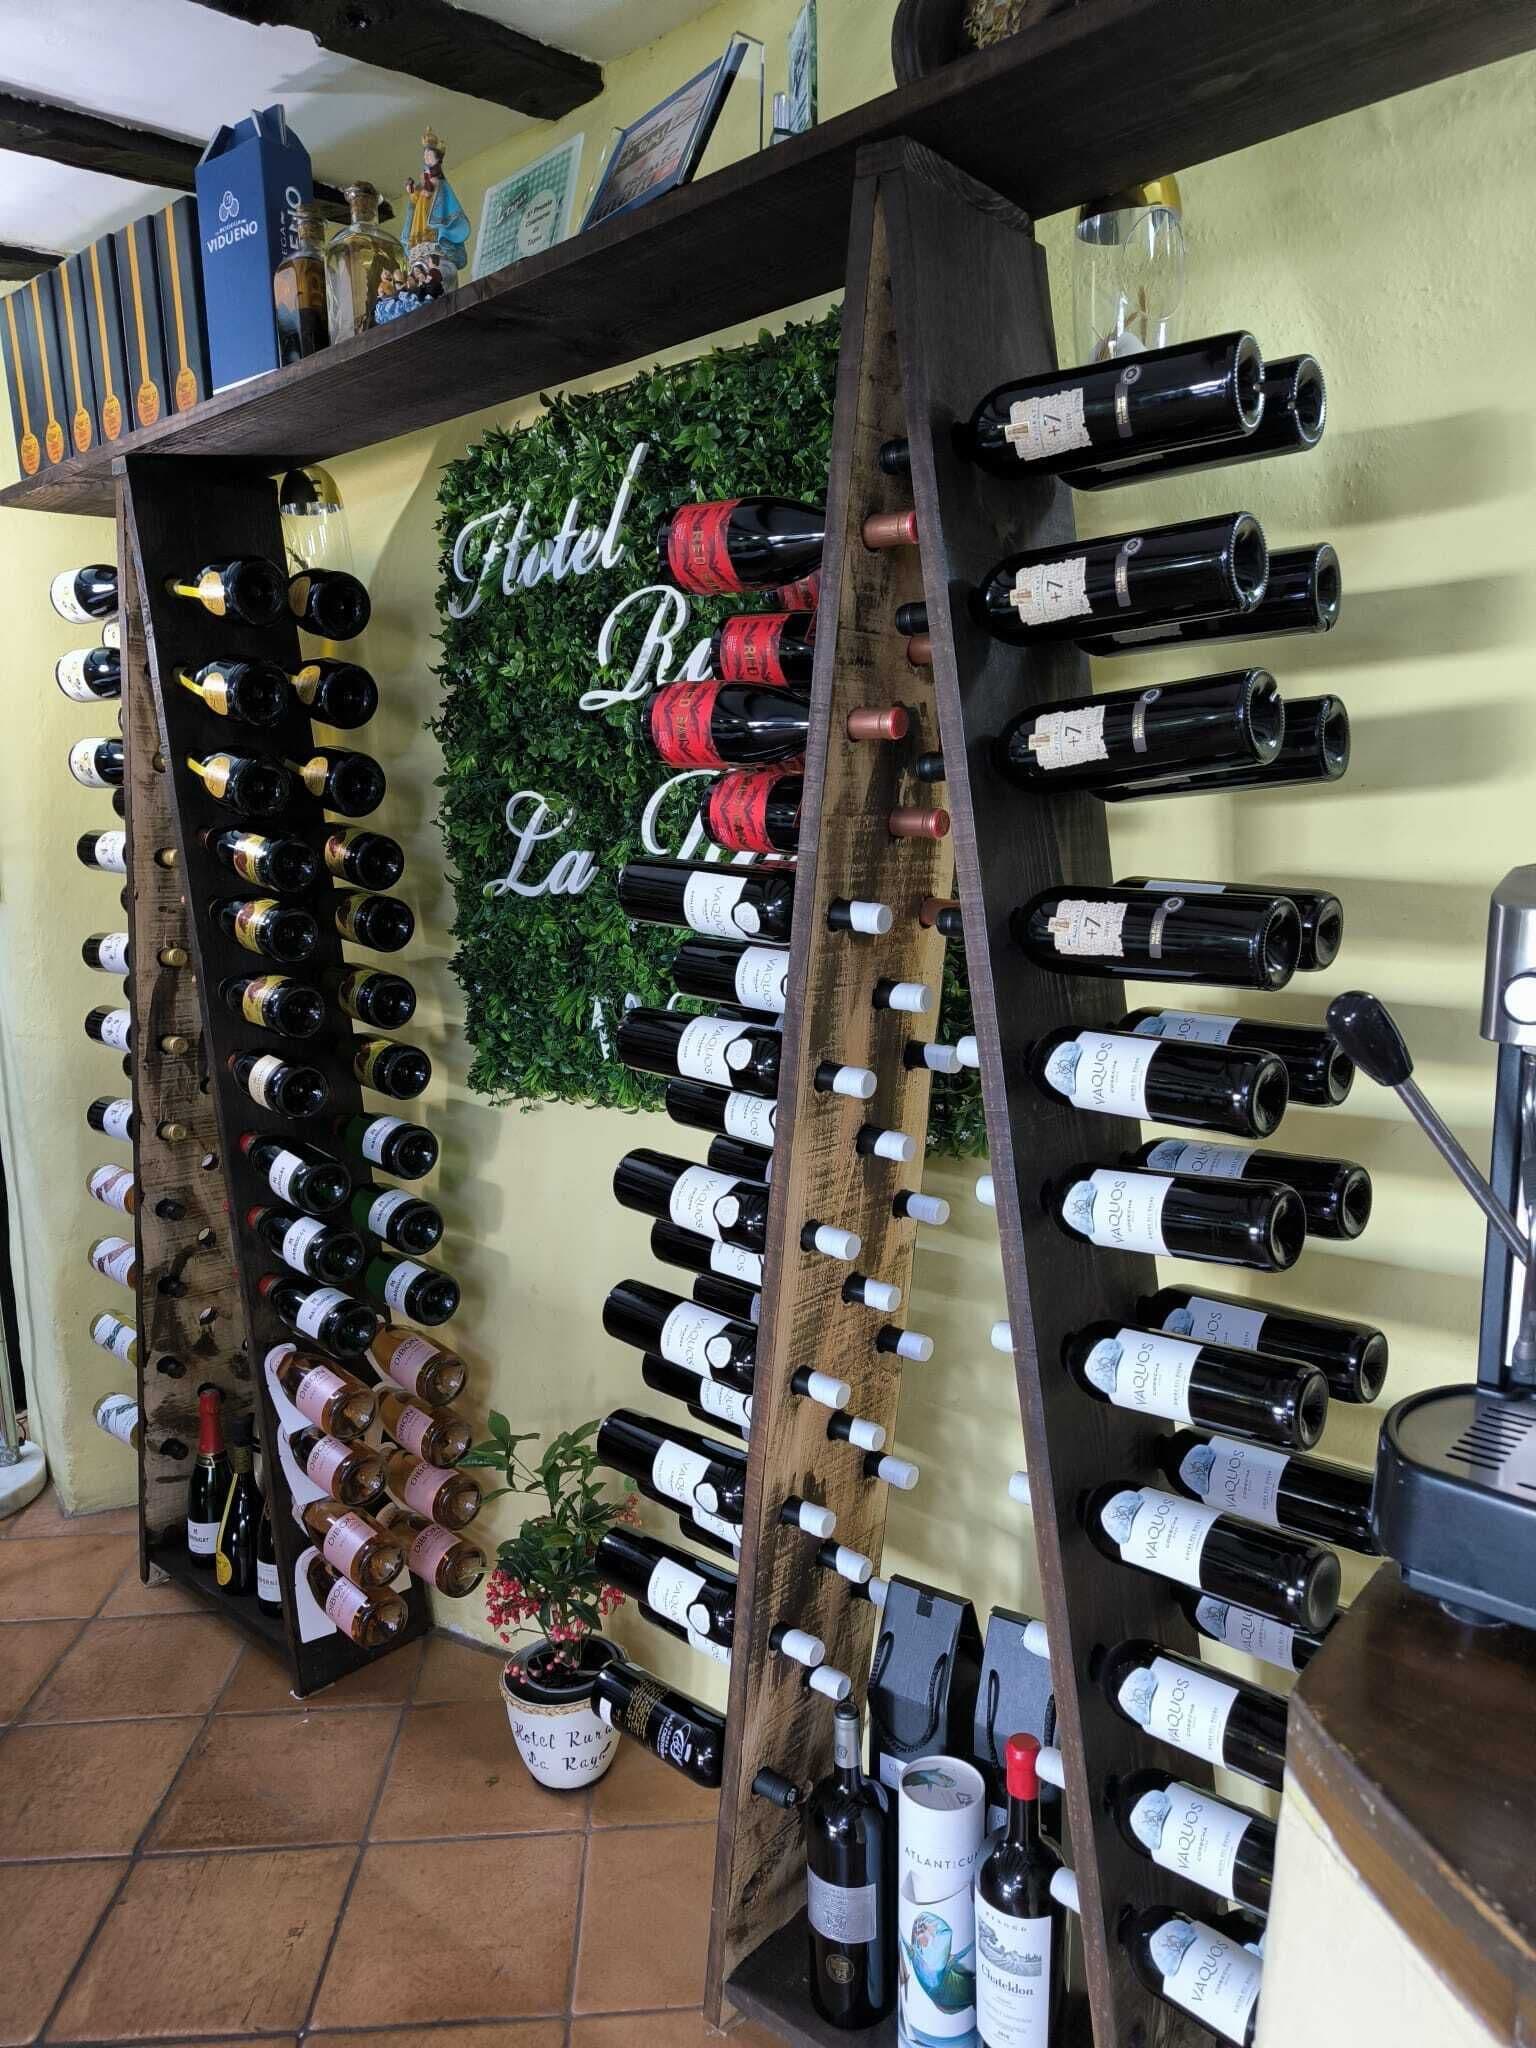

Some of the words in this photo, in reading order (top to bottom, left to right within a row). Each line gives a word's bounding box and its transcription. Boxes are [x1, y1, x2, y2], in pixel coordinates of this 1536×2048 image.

[206, 220, 259, 254] VIDUENO
[448, 442, 650, 619] Hotel
[483, 790, 600, 897] La
[1091, 1042, 1113, 1105] VAQUOS
[1108, 1180, 1128, 1243] VAQUOS
[299, 1368, 326, 1401] DIBON
[1132, 1342, 1155, 1405] VAQUOS
[1225, 1449, 1246, 1508] VAQUOS
[1145, 1496, 1177, 1560] VAQUOS
[327, 1580, 348, 1617] DIBON
[513, 1720, 557, 1750] Hotel
[565, 1724, 614, 1749] Rura
[1166, 1678, 1191, 1743] VAQUOS
[904, 1846, 978, 1870] ATLANTICU
[1176, 1801, 1205, 1870] VAQUOS
[981, 1963, 1034, 1996] Chateldon
[1191, 1941, 1230, 2002] VAQUOS
